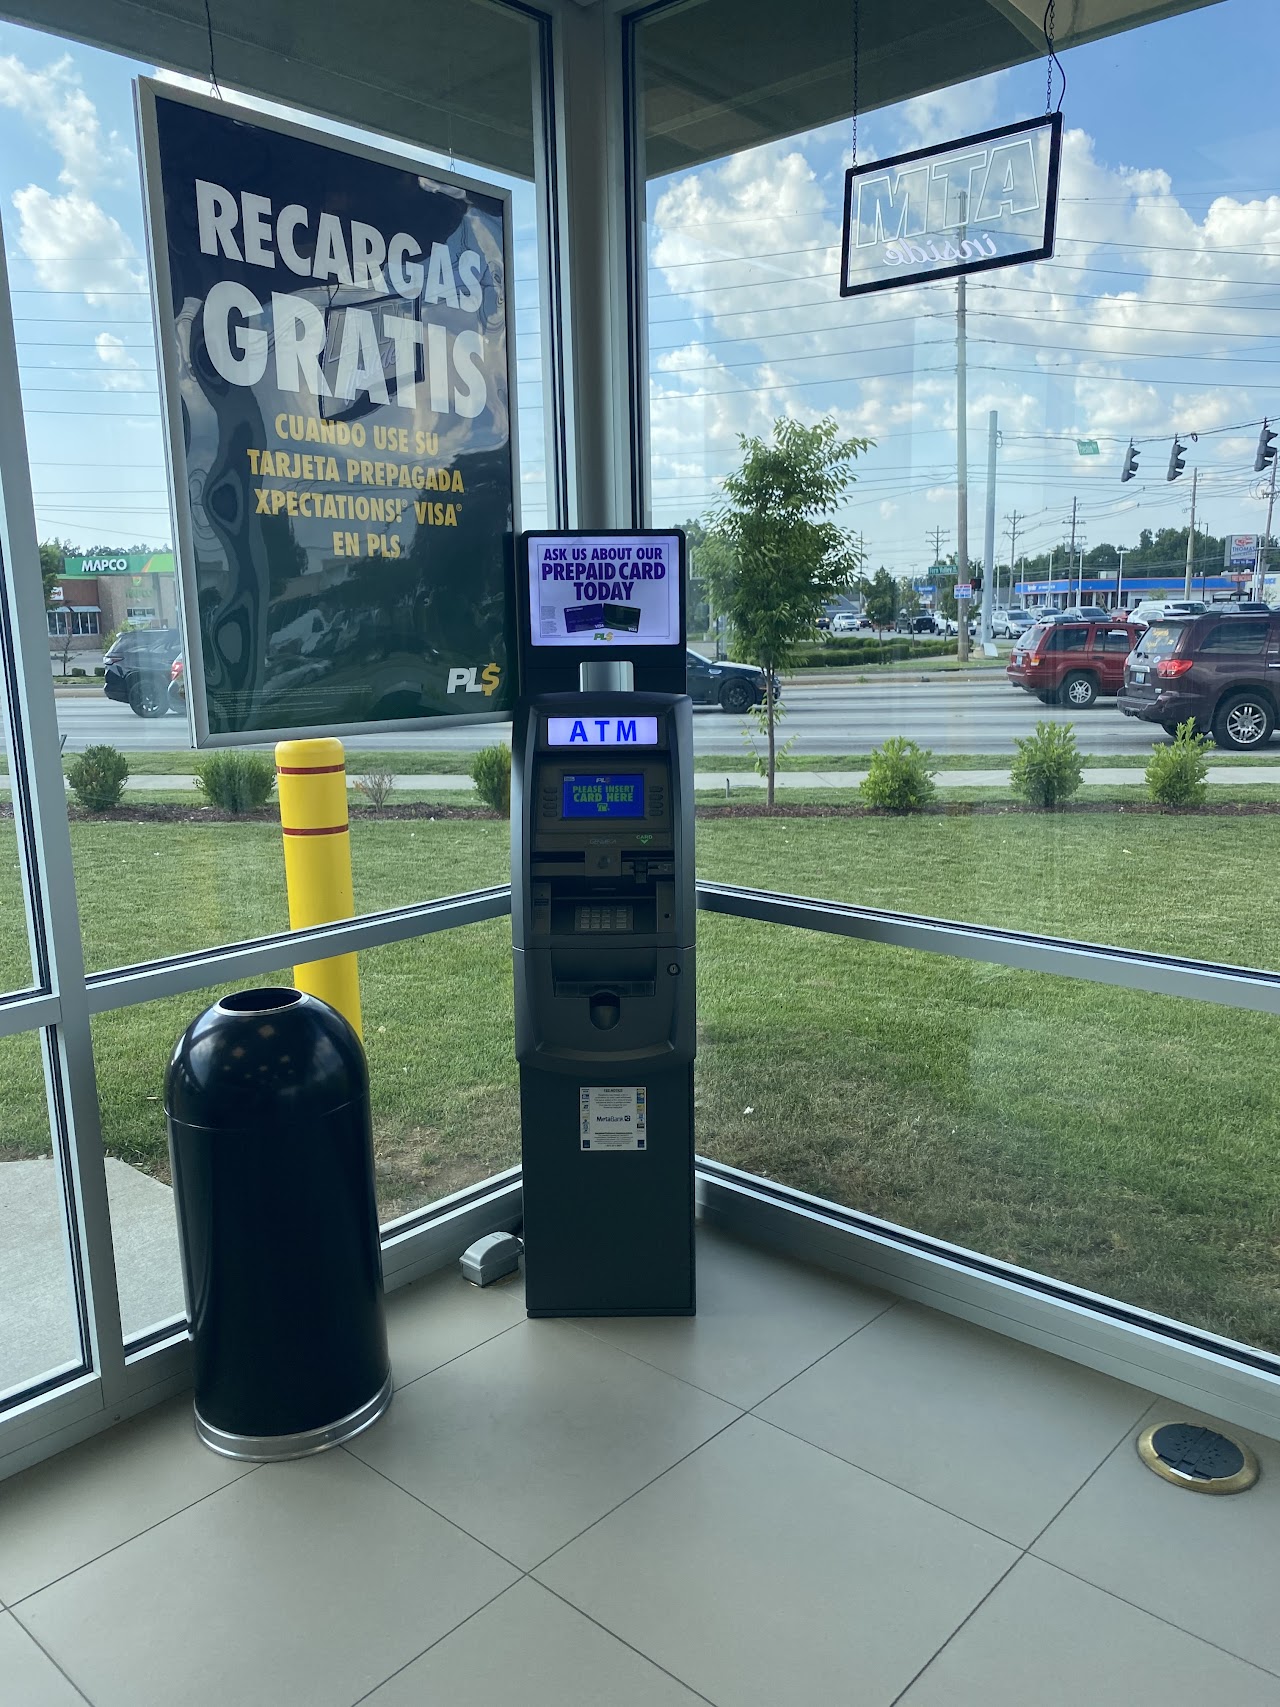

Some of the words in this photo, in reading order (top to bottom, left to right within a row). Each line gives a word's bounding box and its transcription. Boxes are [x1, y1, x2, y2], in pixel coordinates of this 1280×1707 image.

[195, 178, 485, 313] RECARGAS
[203, 280, 487, 418] GRATIS
[274, 413, 366, 447] CUANDO
[373, 425, 409, 453] USE
[415, 430, 439, 456] SU
[246, 449, 340, 483] TARJETA
[346, 459, 465, 494] PREPAGADA
[332, 531, 360, 557] EN
[367, 533, 401, 559] PLS
[544, 548, 568, 560] ASK
[572, 548, 587, 560] US
[591, 548, 632, 560] ABOUT
[636, 547, 662, 560] OUR
[81, 558, 128, 572] MAPCO
[541, 562, 616, 580] PREPAID
[618, 562, 666, 580] CARD
[574, 582, 634, 600] TODAY
[569, 720, 637, 742] ATM
[574, 793, 602, 802] CARD
[607, 793, 633, 802] HERE
[606, 785, 634, 793] INSERT
